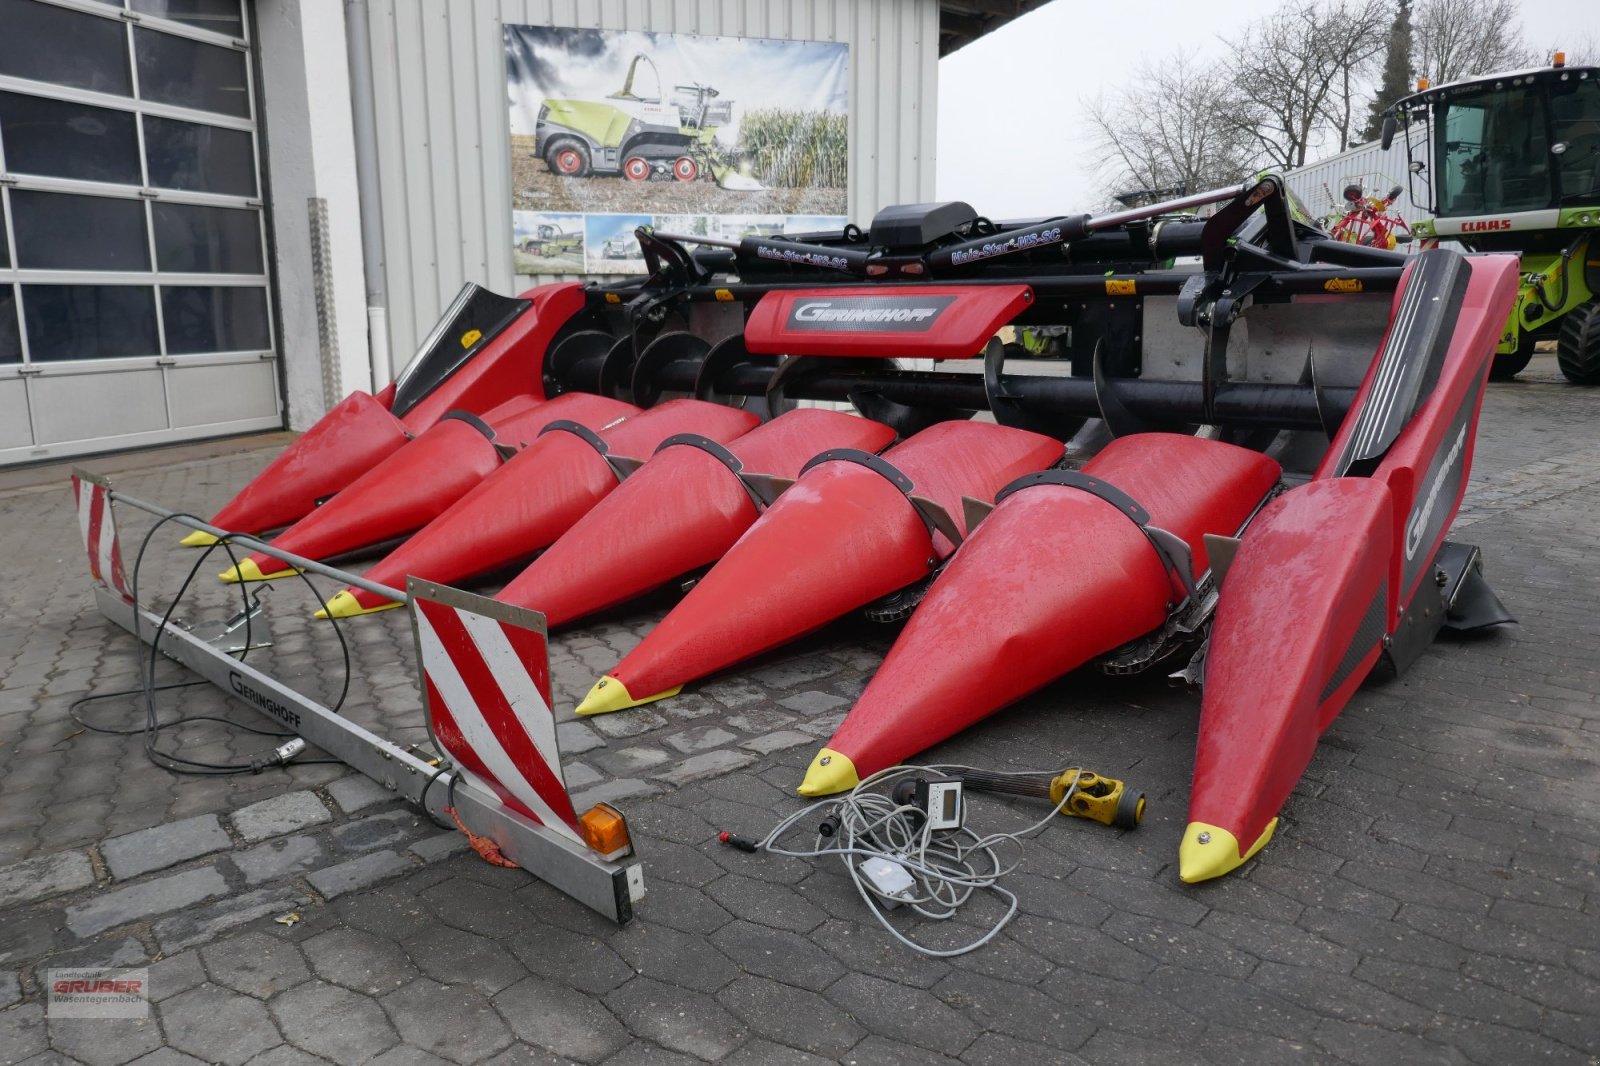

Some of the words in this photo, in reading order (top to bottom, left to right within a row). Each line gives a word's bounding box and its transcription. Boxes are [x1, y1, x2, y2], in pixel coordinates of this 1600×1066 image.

[1461, 219, 1511, 232] CLAAS
[795, 302, 938, 322] GERINGHOFF
[229, 670, 302, 728] GERINGHOFF
